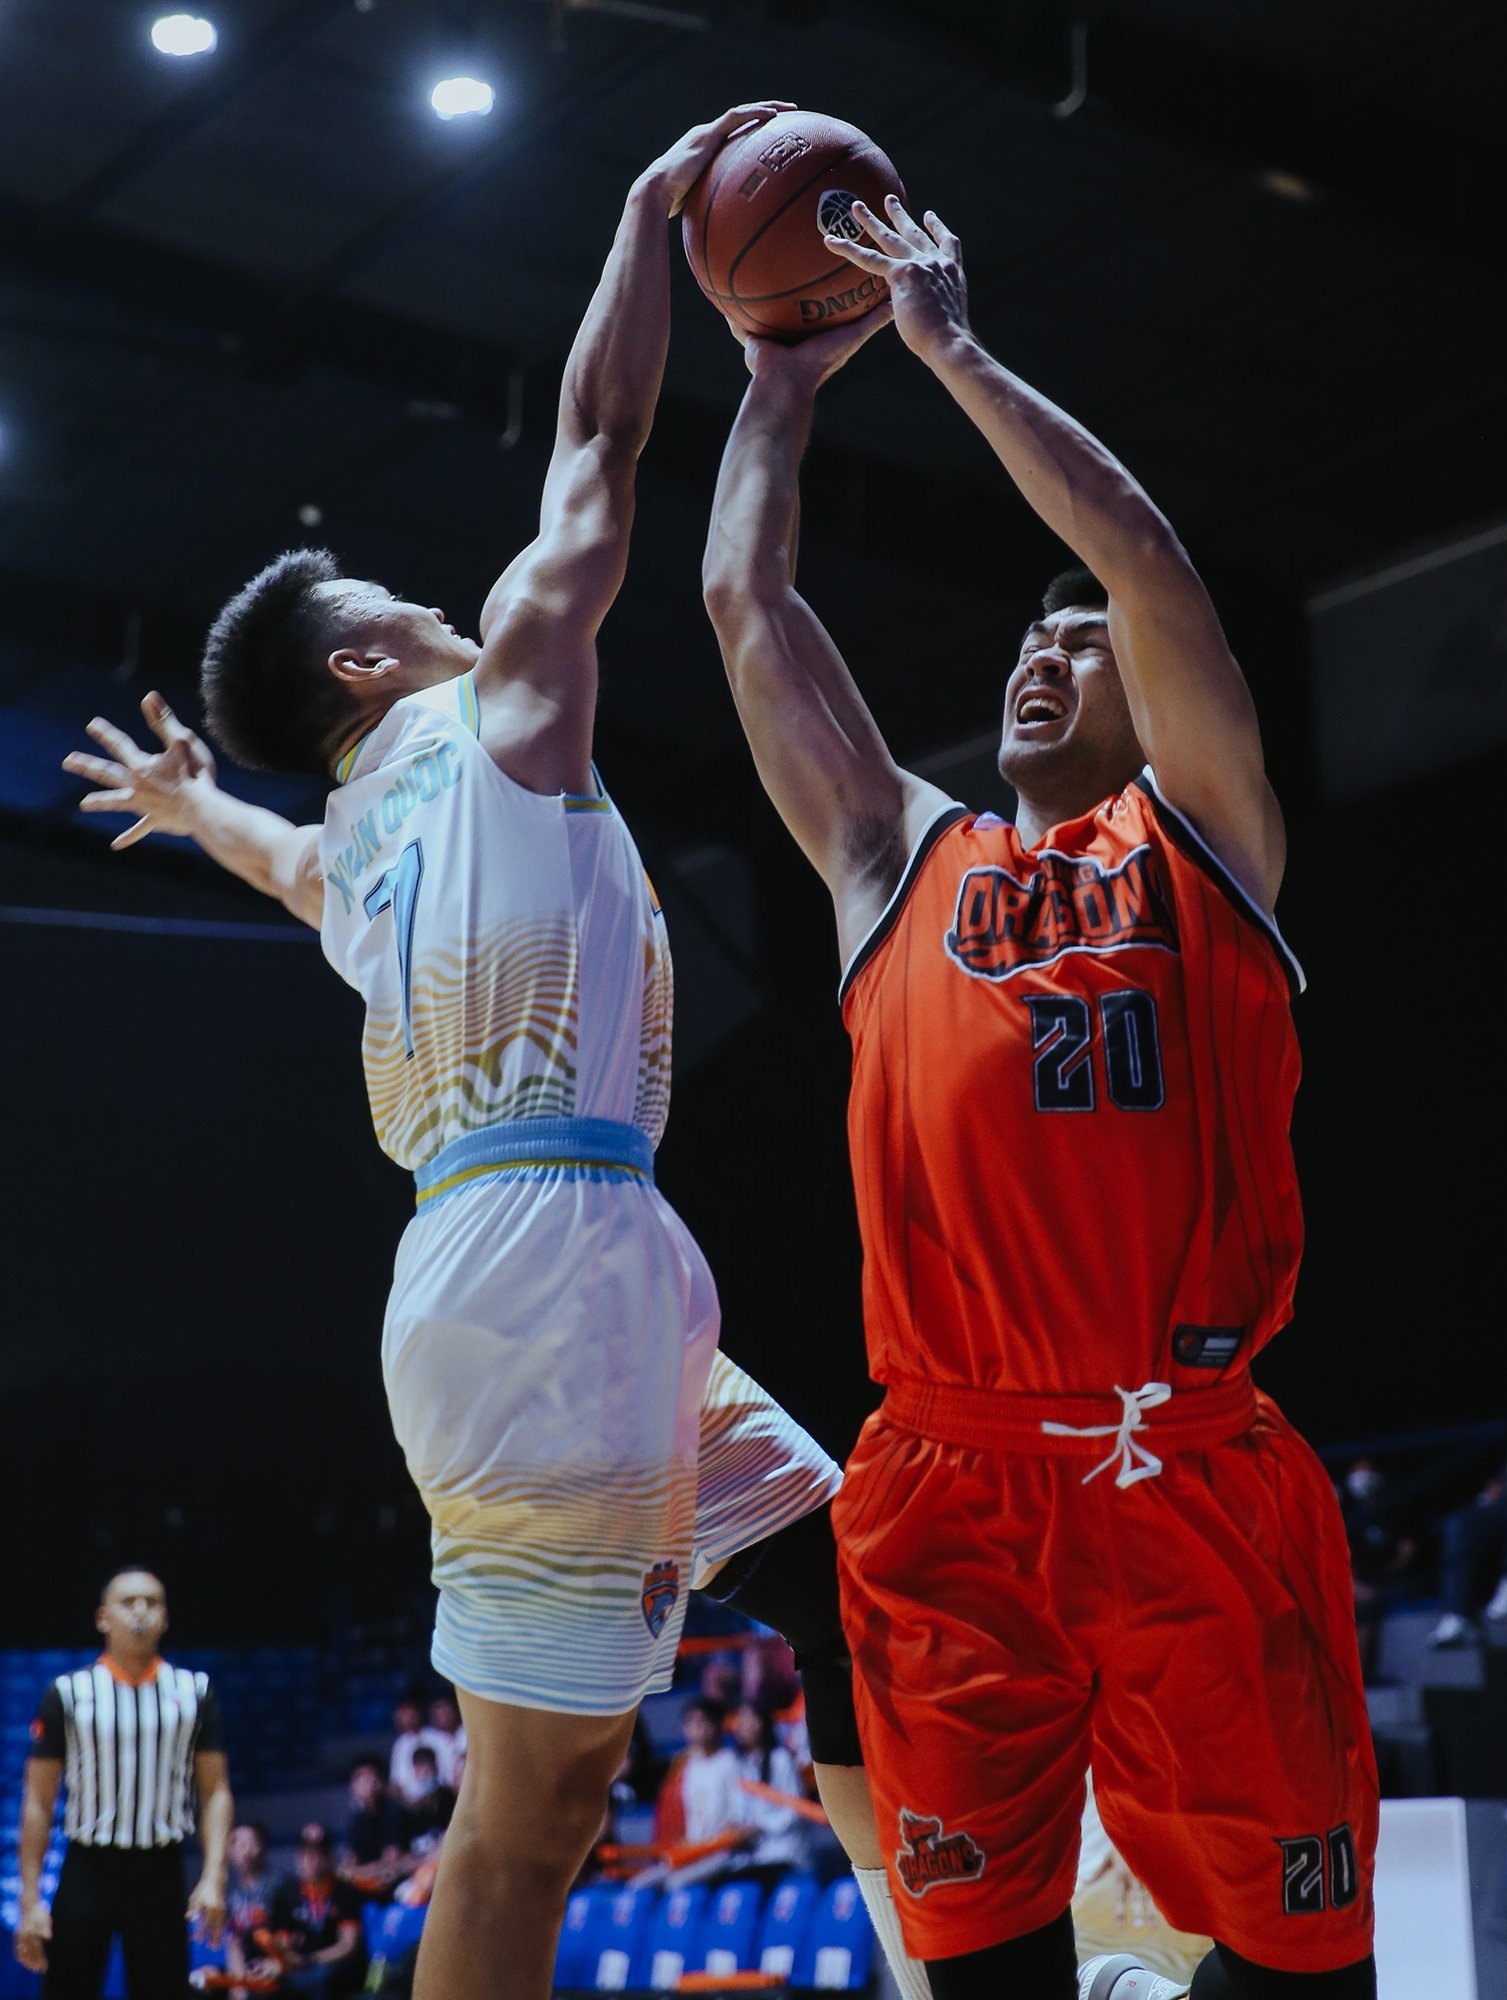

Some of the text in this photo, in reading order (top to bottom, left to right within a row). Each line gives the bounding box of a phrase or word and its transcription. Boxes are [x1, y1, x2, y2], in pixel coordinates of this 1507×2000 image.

[828, 215, 864, 240] BA
[1021, 988, 1165, 1113] 20
[1271, 1821, 1358, 1915] 20
